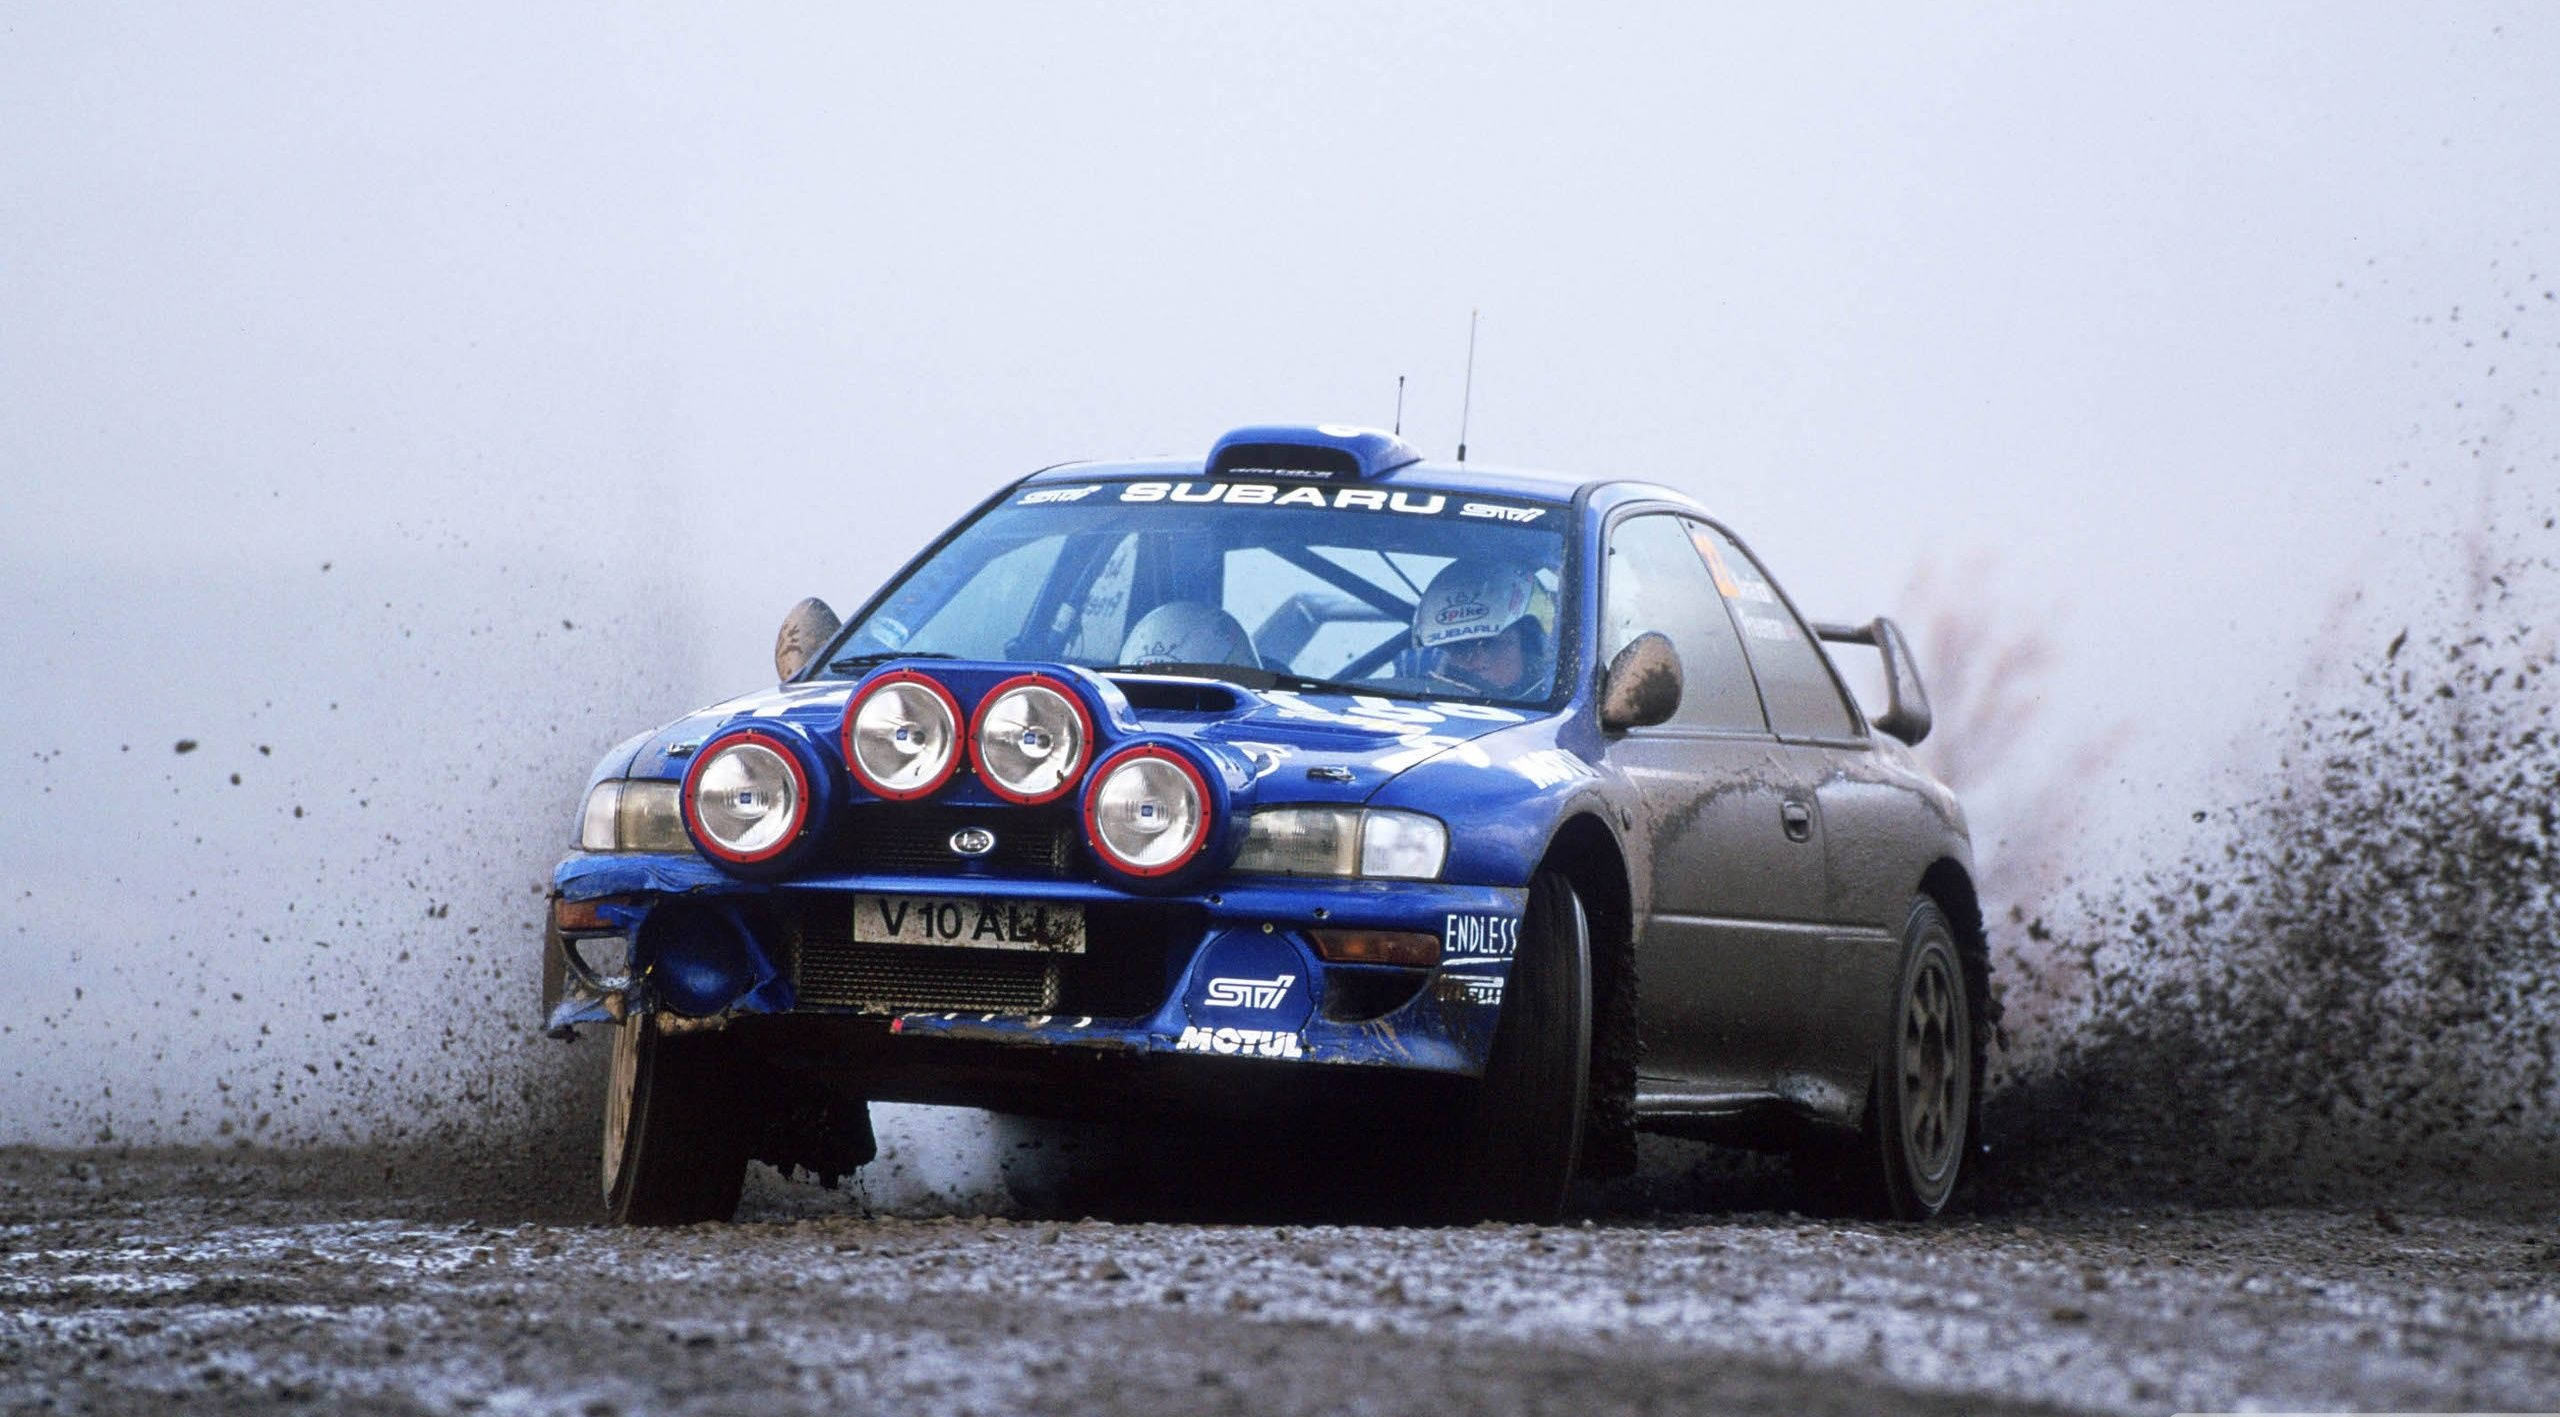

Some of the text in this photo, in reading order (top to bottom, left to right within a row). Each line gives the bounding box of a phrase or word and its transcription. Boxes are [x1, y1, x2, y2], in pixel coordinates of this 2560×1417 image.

[1120, 482, 1446, 514] SUBARU
[879, 900, 909, 937] V
[918, 902, 964, 940] 10
[1445, 914, 1517, 954] ENDLESS
[1176, 1026, 1303, 1058] MOTUL
